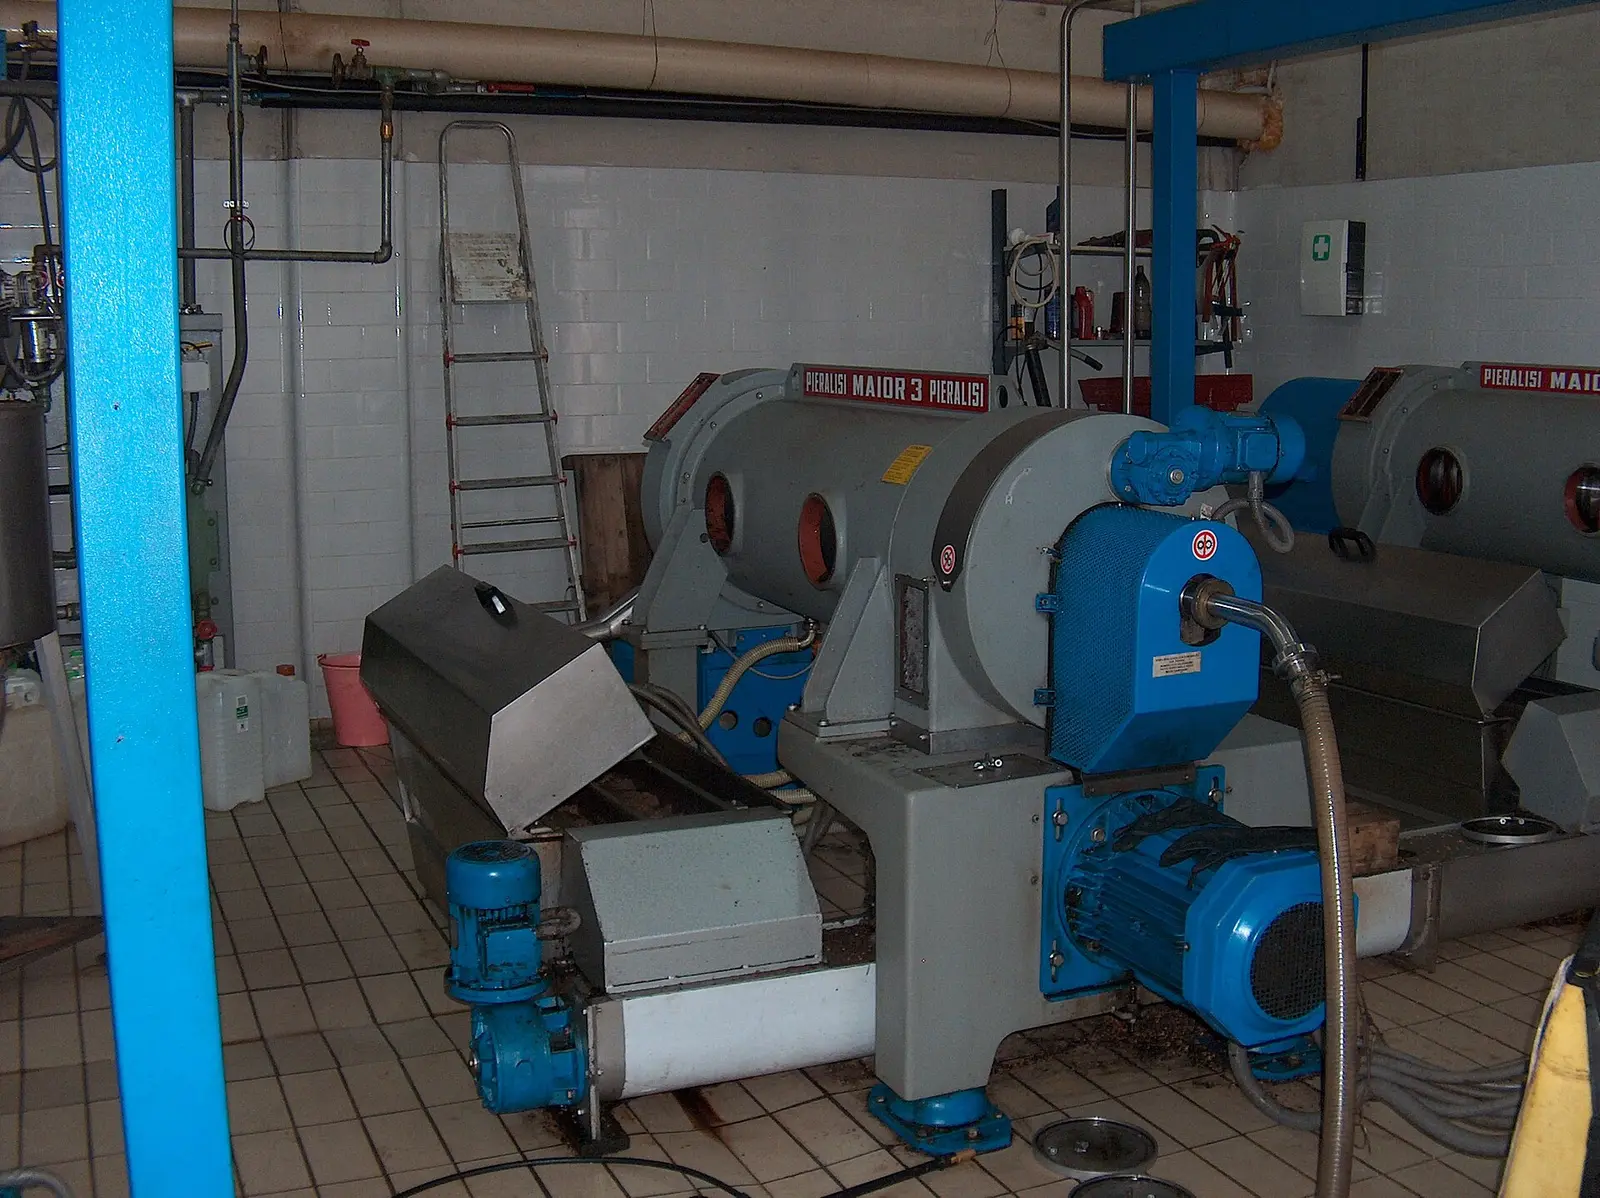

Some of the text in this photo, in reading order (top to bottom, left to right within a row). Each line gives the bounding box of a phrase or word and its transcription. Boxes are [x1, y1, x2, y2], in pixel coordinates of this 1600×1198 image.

[806, 371, 984, 407] PIERALISI MAIOR 3 PIERALISI
[1484, 368, 1542, 388] PIERALISI
